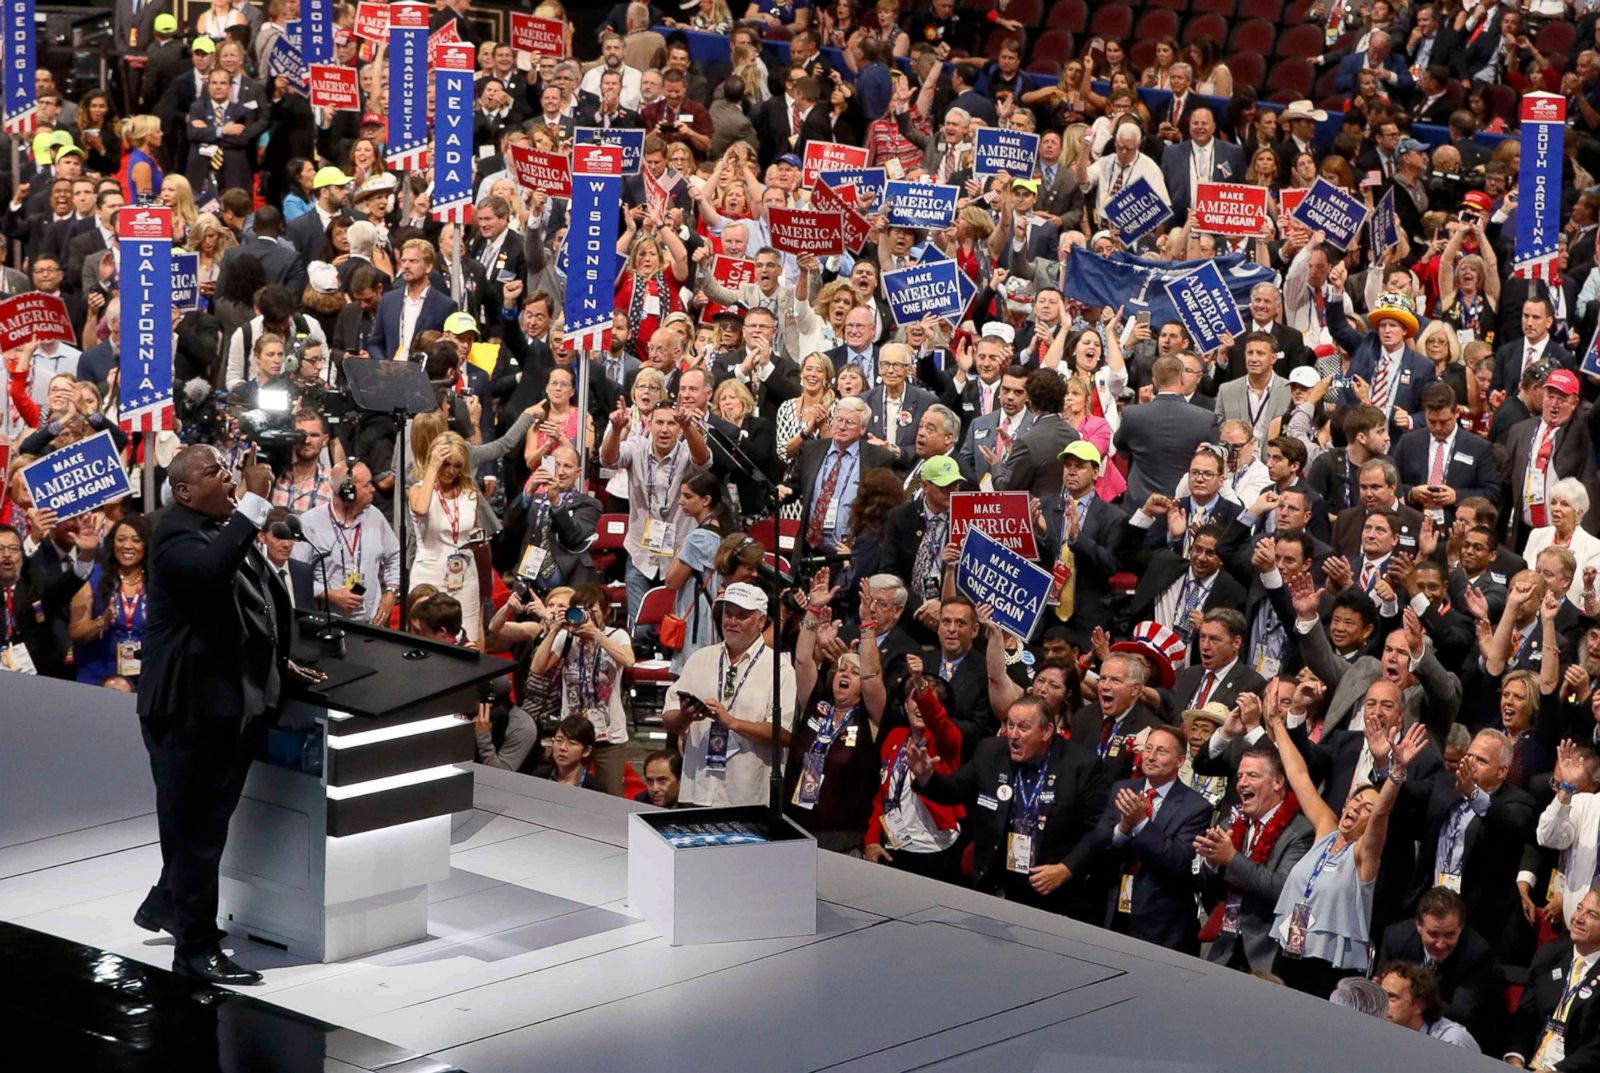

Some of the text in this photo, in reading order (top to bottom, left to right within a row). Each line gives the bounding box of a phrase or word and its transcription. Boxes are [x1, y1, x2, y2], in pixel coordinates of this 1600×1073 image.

[311, 0, 323, 56] SOURI
[513, 26, 562, 44] AMERICA
[14, 2, 27, 98] GEORGIA
[313, 79, 357, 94] AMERICA
[403, 31, 415, 140] MASSACHUSETTS
[445, 78, 462, 183] NEVADA
[998, 136, 1021, 146] MAKE
[1536, 125, 1548, 168] SOUTH
[528, 154, 549, 166] MAKE
[823, 150, 846, 159] MAKE
[977, 144, 1034, 162] AMERICA
[515, 160, 570, 182] AMERICA
[985, 157, 1028, 172] ONE AGAIN
[522, 173, 564, 191] ONE AGAIN
[841, 175, 864, 184] MAKE
[909, 188, 934, 197] MAKE
[1116, 193, 1136, 209] MAKE
[1219, 191, 1244, 200] MAKE
[1196, 199, 1264, 217] AMERICA
[1329, 194, 1350, 211] MAKE
[1533, 176, 1546, 245] CAROLINA
[791, 216, 817, 225] MAKE
[893, 208, 945, 220] ONE AGAIN
[1124, 205, 1161, 234] ONE AGAIN
[1204, 214, 1256, 227] ONE AGAIN
[1304, 194, 1358, 234] AMERICA
[771, 223, 842, 240] AMERICA
[1306, 209, 1326, 226] ONE
[1323, 219, 1348, 239] AGAIN
[584, 181, 605, 310] WISCONSIN
[780, 237, 833, 249] ONE AGAIN
[171, 274, 197, 289] RICA
[906, 273, 932, 285] MAKE
[171, 290, 191, 301] GAIN
[890, 279, 957, 305] AMERICA
[16, 300, 45, 311] MAKE
[902, 302, 922, 314] ONE
[921, 296, 951, 311] AGAIN
[1211, 288, 1229, 315] MAKE
[0, 309, 70, 335] AMERICA
[138, 244, 154, 389] CALIFORNIA
[1180, 289, 1198, 312] ONE
[1192, 311, 1215, 341] AGAIN
[8, 322, 65, 341] ONE AGAIN
[52, 453, 85, 473] MAKE
[35, 455, 120, 503] AMERICA
[49, 490, 77, 509] ONE
[77, 474, 116, 499] AGAIN
[974, 504, 1001, 514] MAKE
[952, 517, 1030, 535] AMERICA
[989, 553, 1021, 579] MAKE
[961, 552, 1038, 614] AMERICA
[967, 576, 1025, 622] ONE AGAIN
